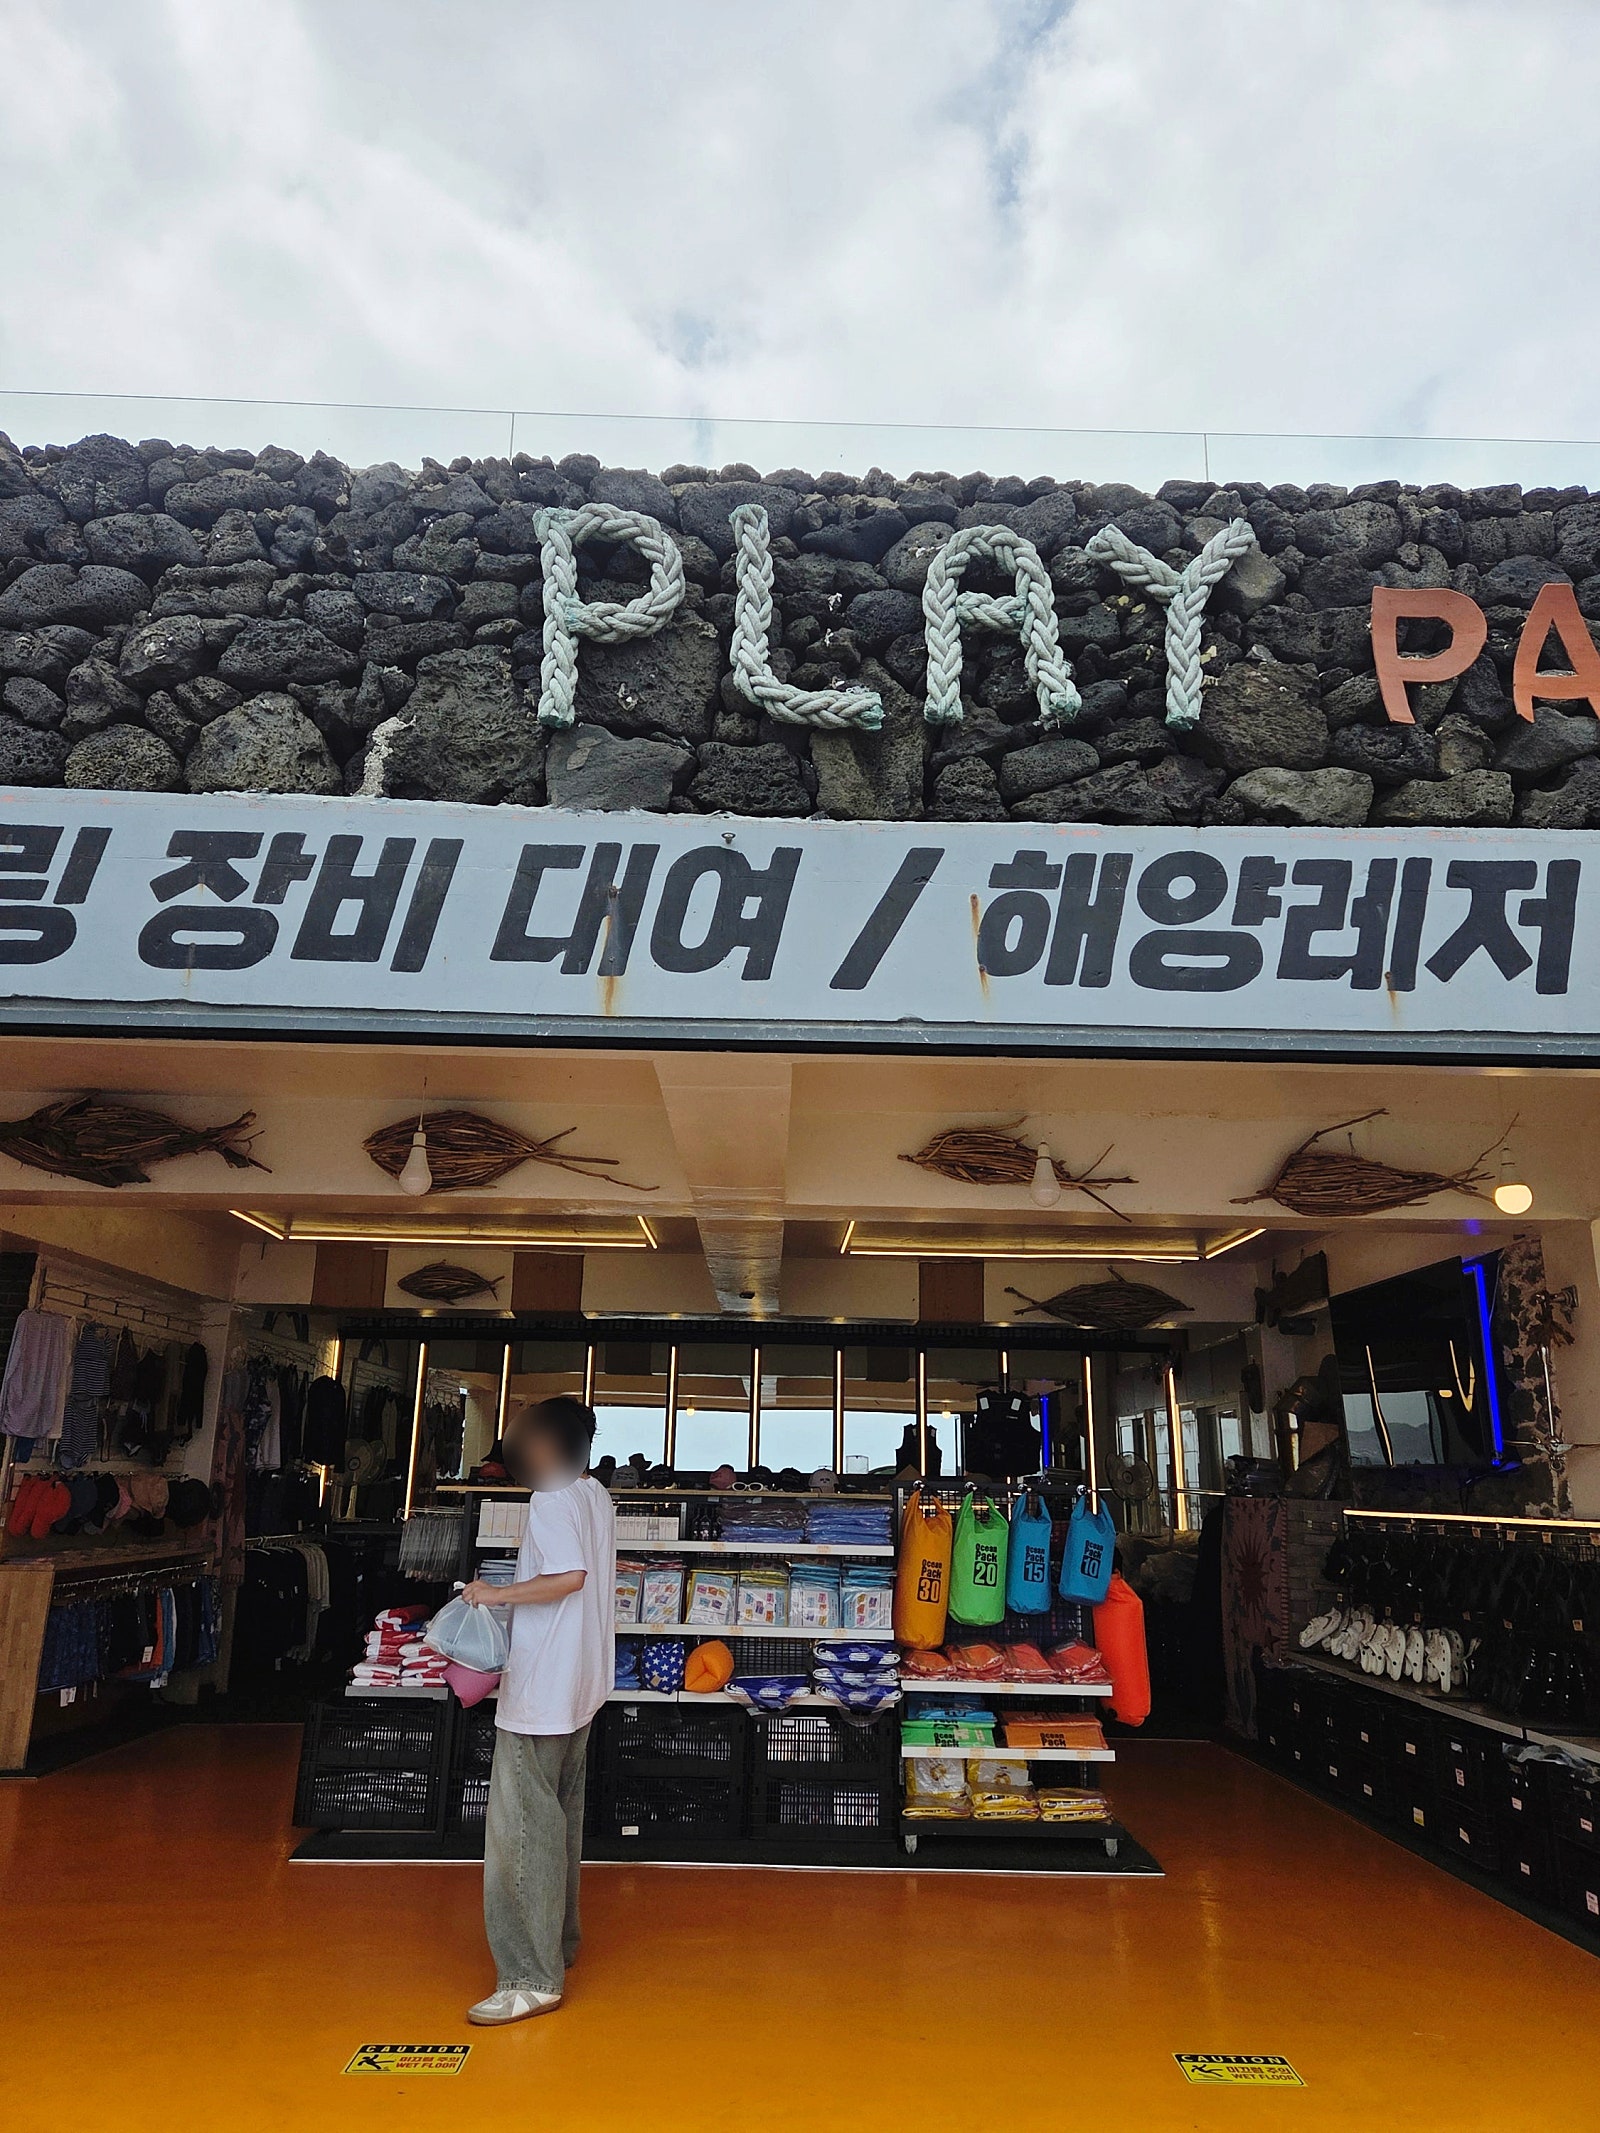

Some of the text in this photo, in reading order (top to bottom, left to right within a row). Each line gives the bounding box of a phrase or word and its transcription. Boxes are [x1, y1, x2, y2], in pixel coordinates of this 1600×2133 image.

[532, 502, 1255, 731] PLAY
[138, 830, 464, 973] 장비
[489, 842, 803, 981] 대여
[829, 847, 945, 990] /
[977, 850, 1582, 995] 해양레저
[975, 1543, 997, 1552] Ocean
[1026, 1545, 1045, 1554] Ocean
[1085, 1540, 1103, 1551] Ocean
[975, 1550, 997, 1562] Pack
[1026, 1552, 1045, 1562] Pack
[1084, 1547, 1102, 1559] Pack
[921, 1559, 942, 1568] Ocean
[1084, 1558, 1099, 1577] 10
[921, 1566, 942, 1578] Pack
[974, 1562, 996, 1585] 20
[1025, 1563, 1044, 1582] 15
[919, 1578, 940, 1602] 30
[1041, 1739, 1066, 1747] Pack
[1181, 2055, 1282, 2064] CAUTION
